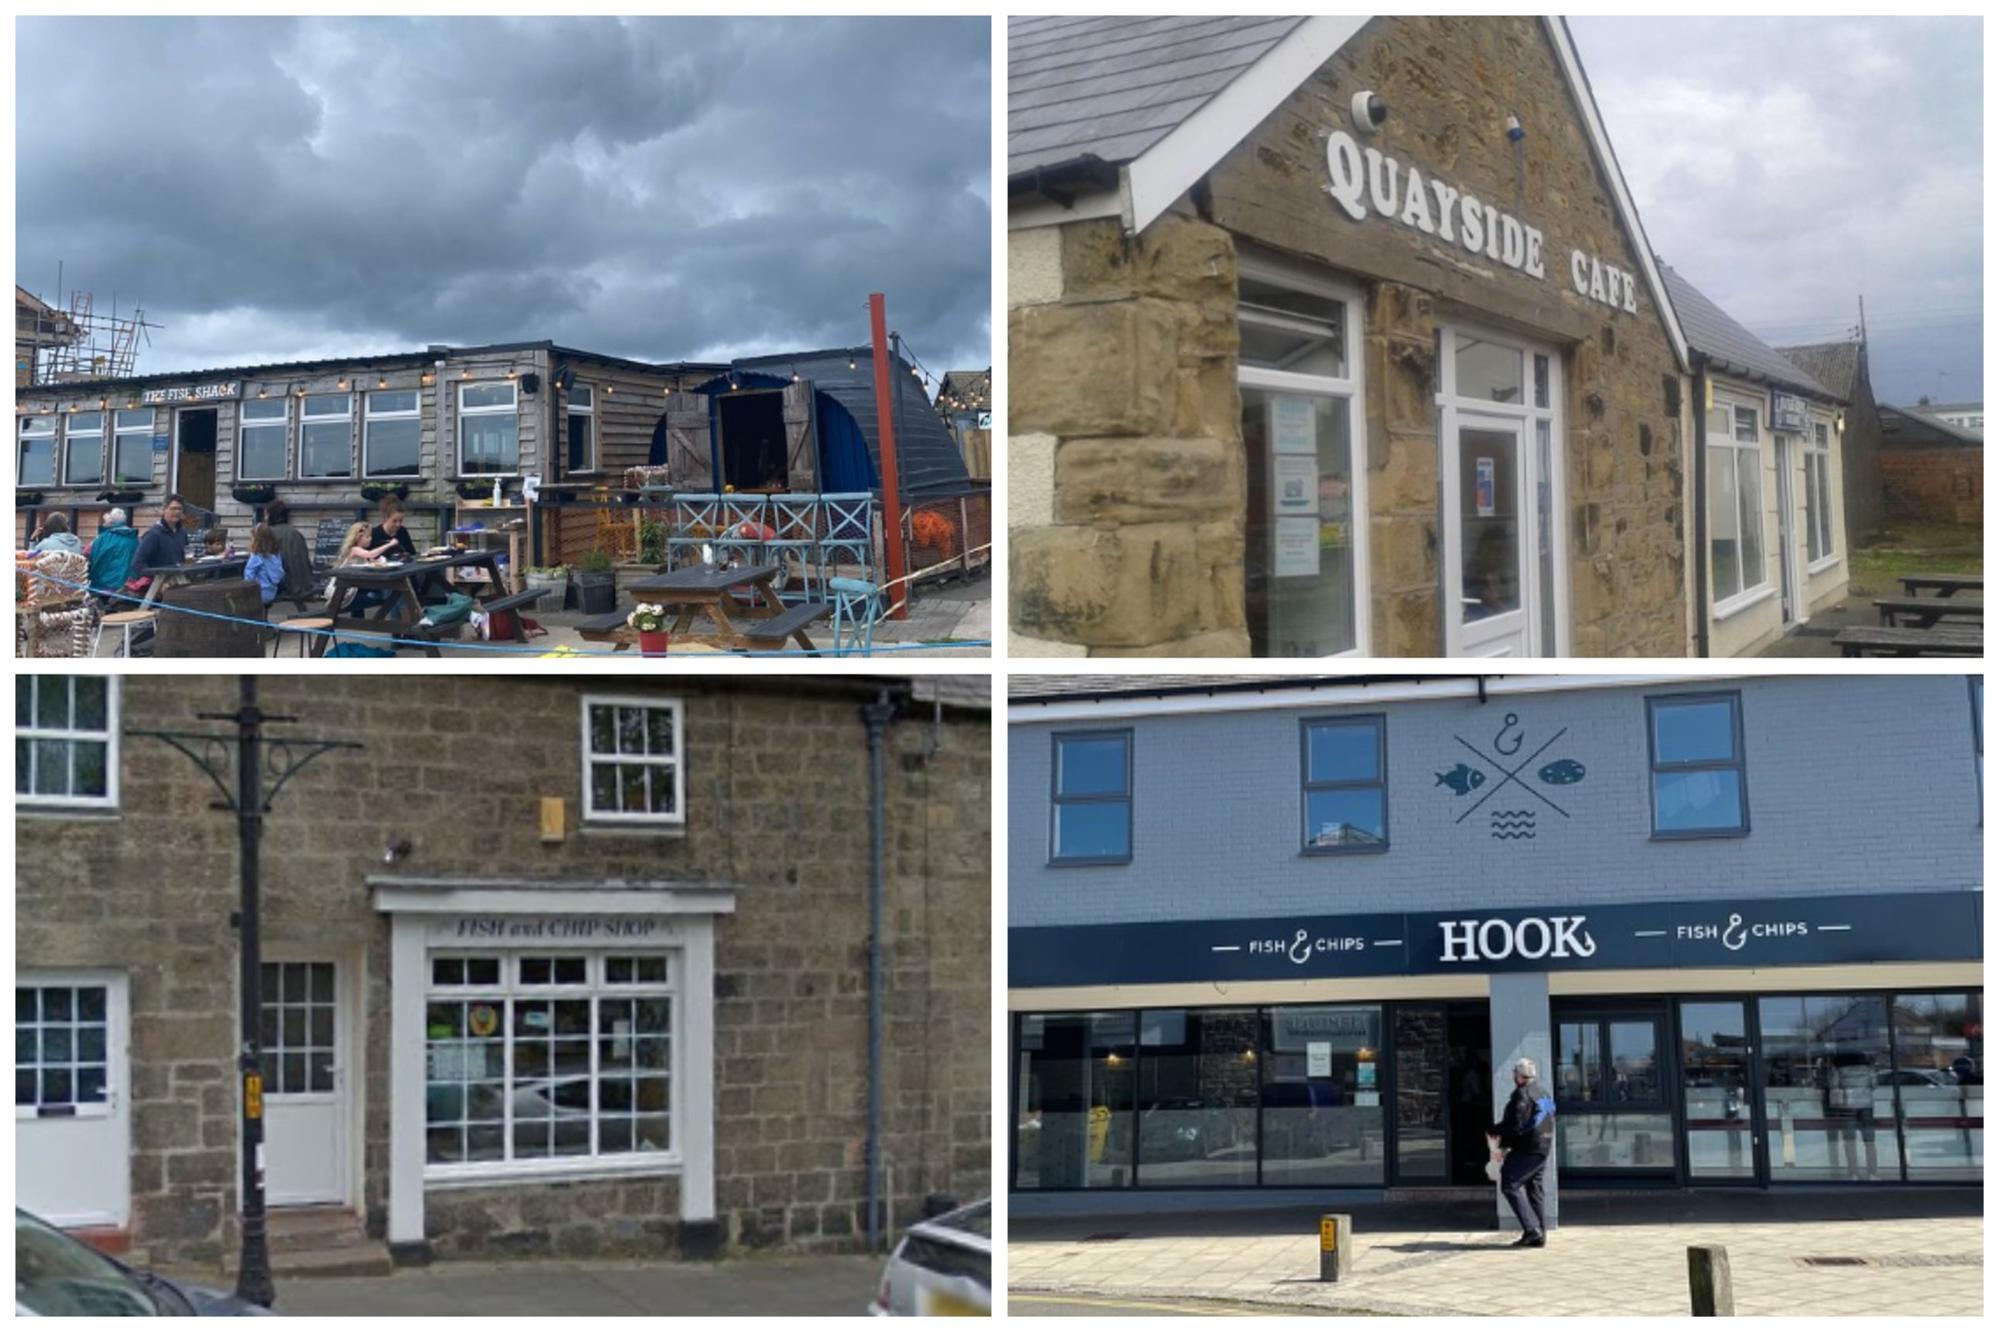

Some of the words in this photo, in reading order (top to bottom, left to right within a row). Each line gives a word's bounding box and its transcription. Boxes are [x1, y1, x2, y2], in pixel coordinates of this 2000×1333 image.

[1327, 130, 1544, 280] QUAYSIDE
[1571, 249, 1637, 315] CAFE
[144, 388, 166, 402] THE
[195, 383, 236, 399] SHACK
[457, 918, 505, 936] FISH
[548, 917, 599, 936] CHIP
[604, 918, 656, 937] SHOP
[1677, 926, 1717, 940] FISH
[1752, 922, 1808, 937] CHIPS
[1250, 940, 1286, 954] FISH
[1315, 937, 1364, 951] CHIPS
[1438, 916, 1597, 962] HOOK
